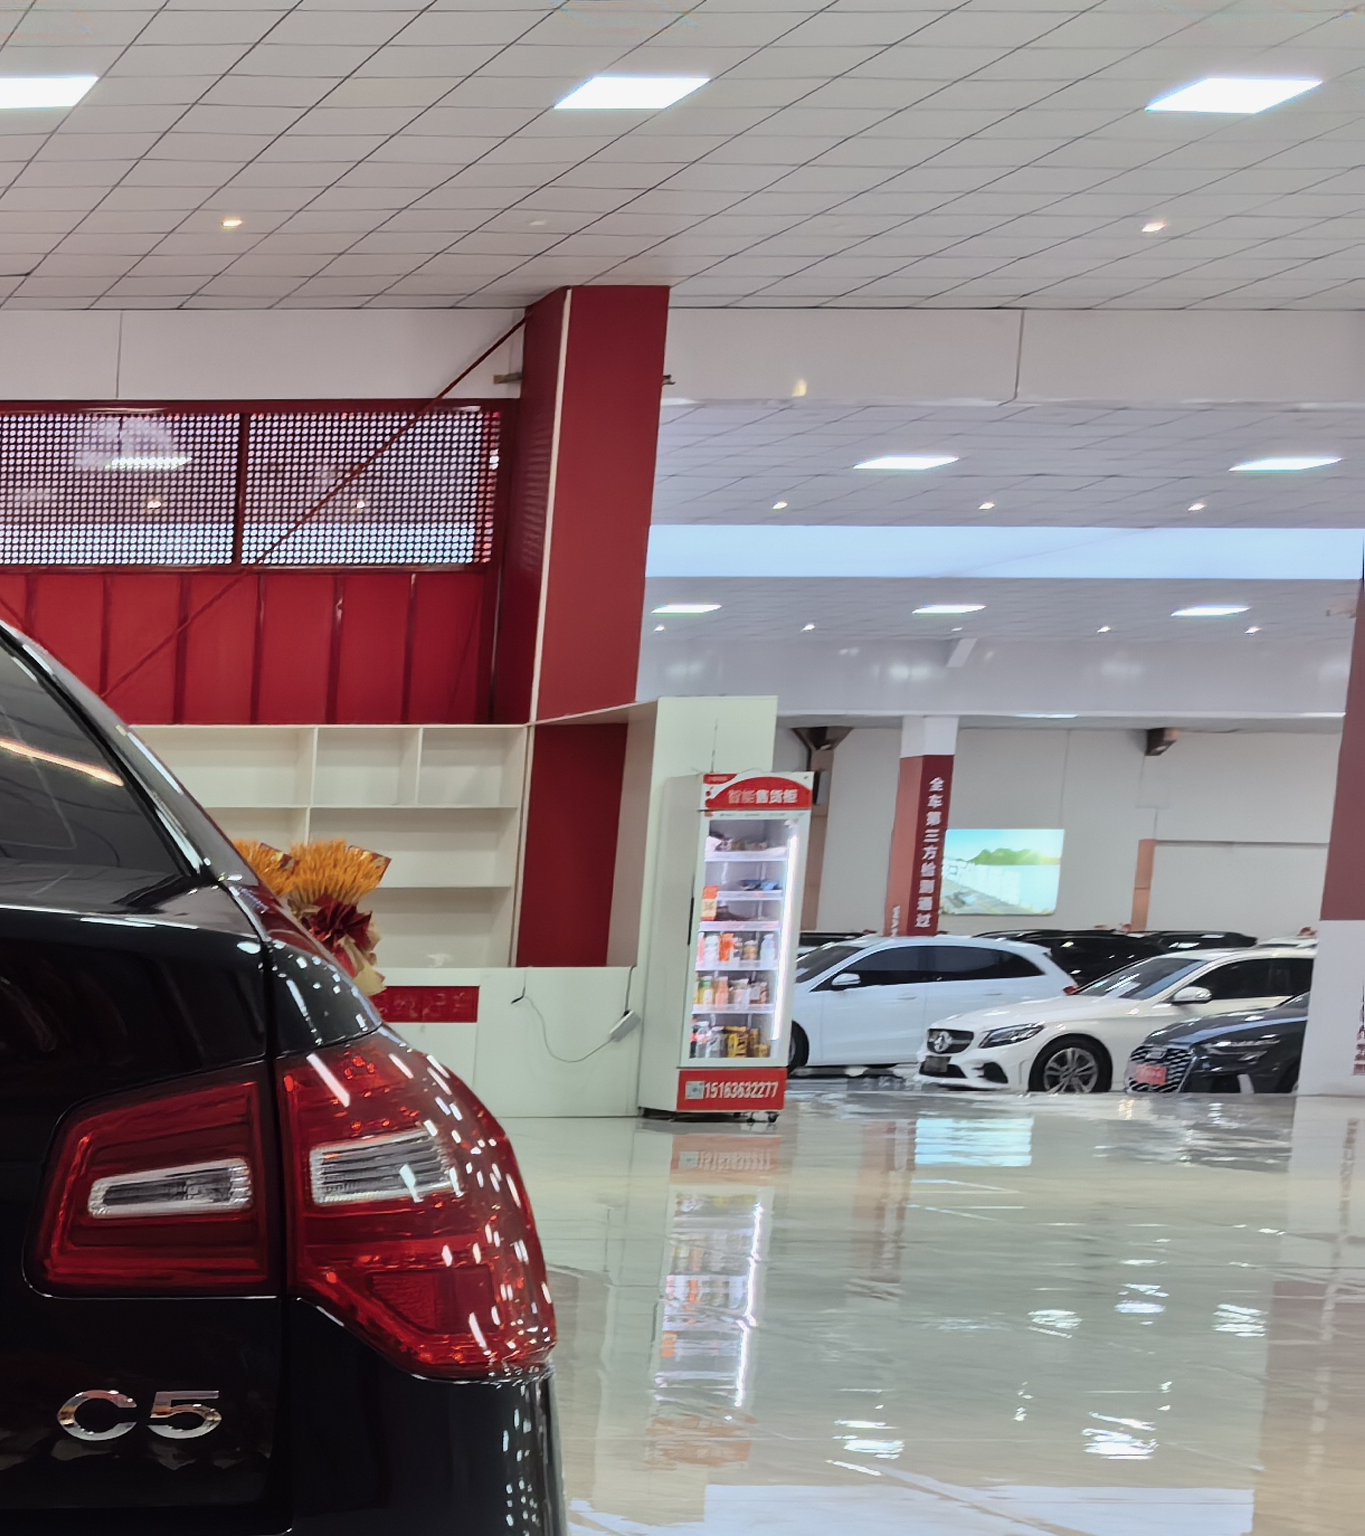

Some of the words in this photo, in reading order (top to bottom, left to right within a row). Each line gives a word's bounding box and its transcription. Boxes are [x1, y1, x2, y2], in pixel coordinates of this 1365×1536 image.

[728, 788, 799, 805] 智能售货柜
[914, 776, 946, 929] 全车第三方检测通过
[704, 1081, 779, 1099] 15163632277
[56, 1390, 223, 1442] C5
